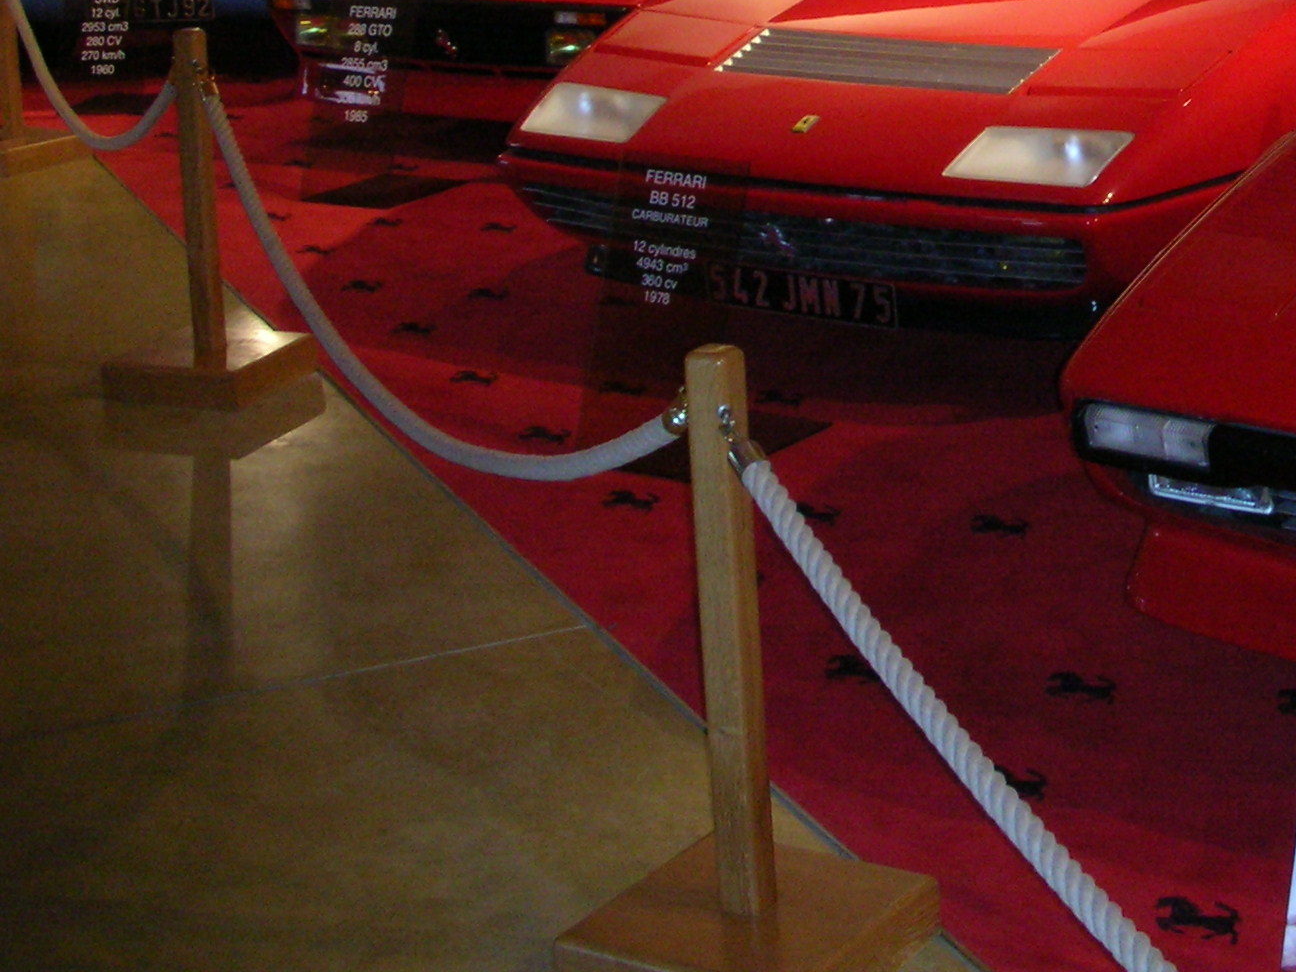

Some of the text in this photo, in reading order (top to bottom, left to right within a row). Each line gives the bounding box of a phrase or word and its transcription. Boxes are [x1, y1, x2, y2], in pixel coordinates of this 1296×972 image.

[92, 8, 103, 17] 12
[349, 6, 396, 19] FERRARI
[108, 21, 129, 32] cm3
[368, 24, 392, 36] GTO
[107, 35, 122, 45] CV
[354, 41, 361, 52] 8
[82, 49, 125, 60] 270 km/h
[343, 75, 362, 87] 400
[646, 169, 707, 189] FERRARI
[649, 190, 696, 209] BB 512
[632, 208, 709, 227] CARBURATEUR
[634, 240, 647, 253] 12
[636, 256, 665, 272] 4943
[664, 279, 678, 289] cv
[645, 290, 670, 305] 1978
[782, 274, 841, 318] JMN
[850, 283, 891, 323] 75
